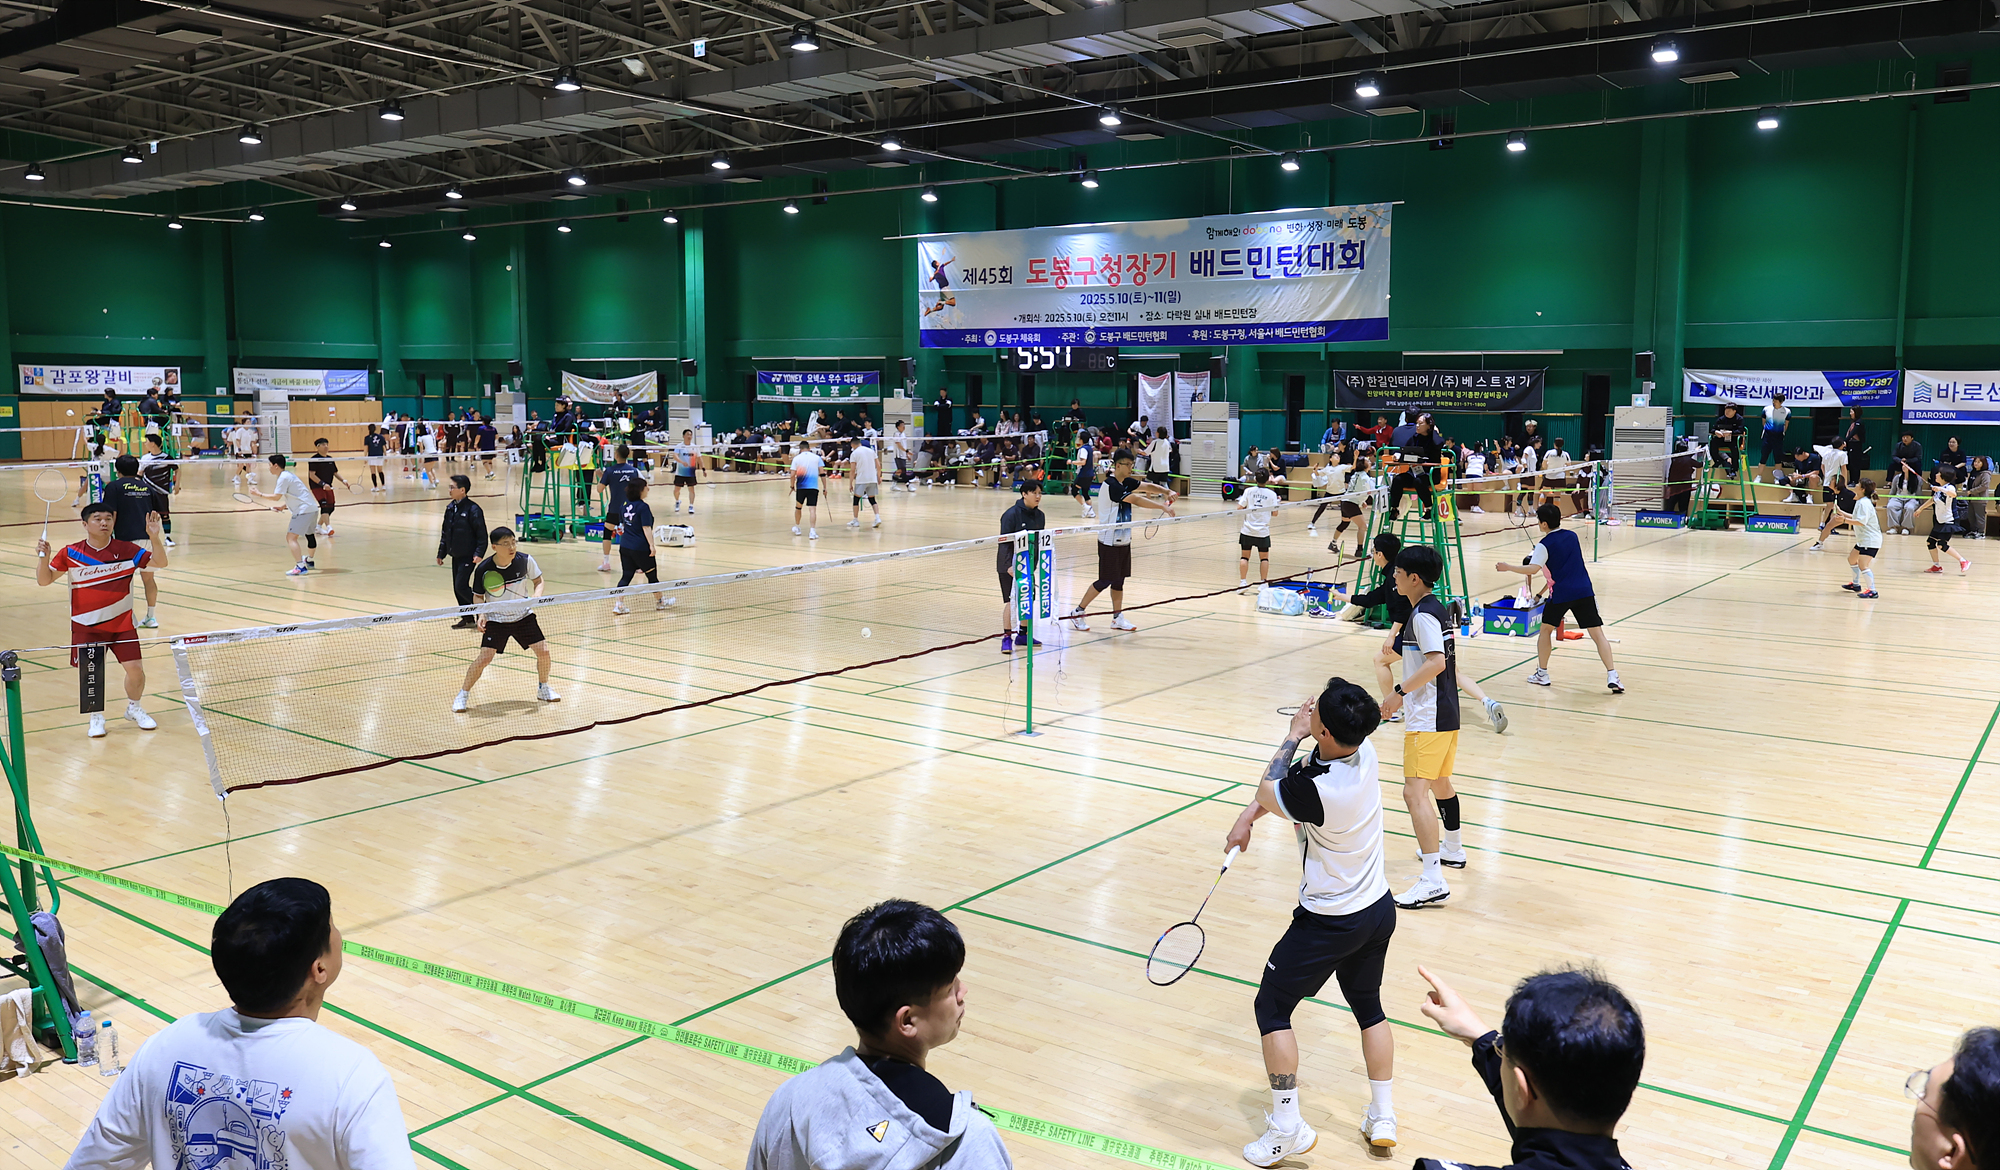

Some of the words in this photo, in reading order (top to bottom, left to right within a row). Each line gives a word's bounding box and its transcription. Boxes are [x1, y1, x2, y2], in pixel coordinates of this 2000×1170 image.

[1206, 227, 1241, 240] 함께해요!
[1347, 216, 1367, 230] 도봉
[962, 265, 1013, 286] 제45회
[1026, 251, 1176, 289] 도봉구청장기
[1189, 240, 1366, 280] 배드민턴대회
[1080, 290, 1182, 306] 2025.5.10(토)~11(일)
[1045, 312, 1096, 323] 2025.5.10(토)
[1099, 312, 1129, 322] 오전11시
[1166, 310, 1191, 321] 다락원
[1194, 309, 1211, 320] 실내
[1214, 308, 1257, 319] 배드민턴장
[999, 333, 1019, 343] 도봉구
[1020, 333, 1041, 343] 체육회
[1099, 331, 1122, 342] 도봉구
[1122, 331, 1168, 342] 배드민턴협회
[1213, 328, 1247, 340] 도봉구청,
[1248, 328, 1274, 339] 서울시
[1275, 326, 1326, 338] 배드민턴협회
[50, 369, 132, 385] 감포왕갈비
[783, 374, 803, 383] YONEX
[807, 373, 826, 383] 요넥스
[828, 373, 841, 383] 우수
[1346, 375, 1364, 388] (주)
[1366, 375, 1429, 387] 한길인테리어
[1431, 375, 1437, 387] /
[1440, 375, 1459, 388] (주)
[1843, 378, 1893, 387] 1599-7397
[1720, 384, 1824, 400] 서울신세계안과
[1916, 411, 1956, 419] BAROSUN
[86, 428, 91, 436] 1
[511, 453, 517, 463] 1
[606, 449, 612, 459] 1
[90, 464, 98, 472] 10
[1382, 495, 1386, 508] 1
[1438, 497, 1449, 516] 12
[1653, 517, 1673, 525] YONEX
[1767, 522, 1788, 530] YONEX
[1017, 536, 1026, 548] 11
[1041, 535, 1051, 546] 12
[78, 563, 122, 577] Technist
[1019, 577, 1030, 616] YONEX
[1041, 576, 1050, 616] YONEX
[459, 605, 478, 613] star
[372, 615, 392, 623] star
[87, 648, 95, 697] 강습코트
[1429, 888, 1443, 896] RYDER
[375, 951, 385, 961] Keep
[385, 954, 395, 965] away
[446, 969, 462, 981] SAFETY
[462, 974, 472, 985] LINE
[519, 989, 532, 1000] Watch
[532, 993, 543, 1003] Your
[544, 995, 554, 1007] Step
[611, 1014, 624, 1026] Keep
[625, 1019, 638, 1030] away
[675, 1030, 702, 1047] 안전통로준수
[703, 1038, 725, 1052] SAFETY
[725, 1043, 739, 1056] LINE
[778, 1055, 799, 1071] 추락주의
[1009, 1115, 1046, 1136] 안전통로준수
[1048, 1125, 1076, 1142] SAFETY
[1077, 1133, 1095, 1148] LINE
[1149, 1149, 1177, 1168] 추락주의
